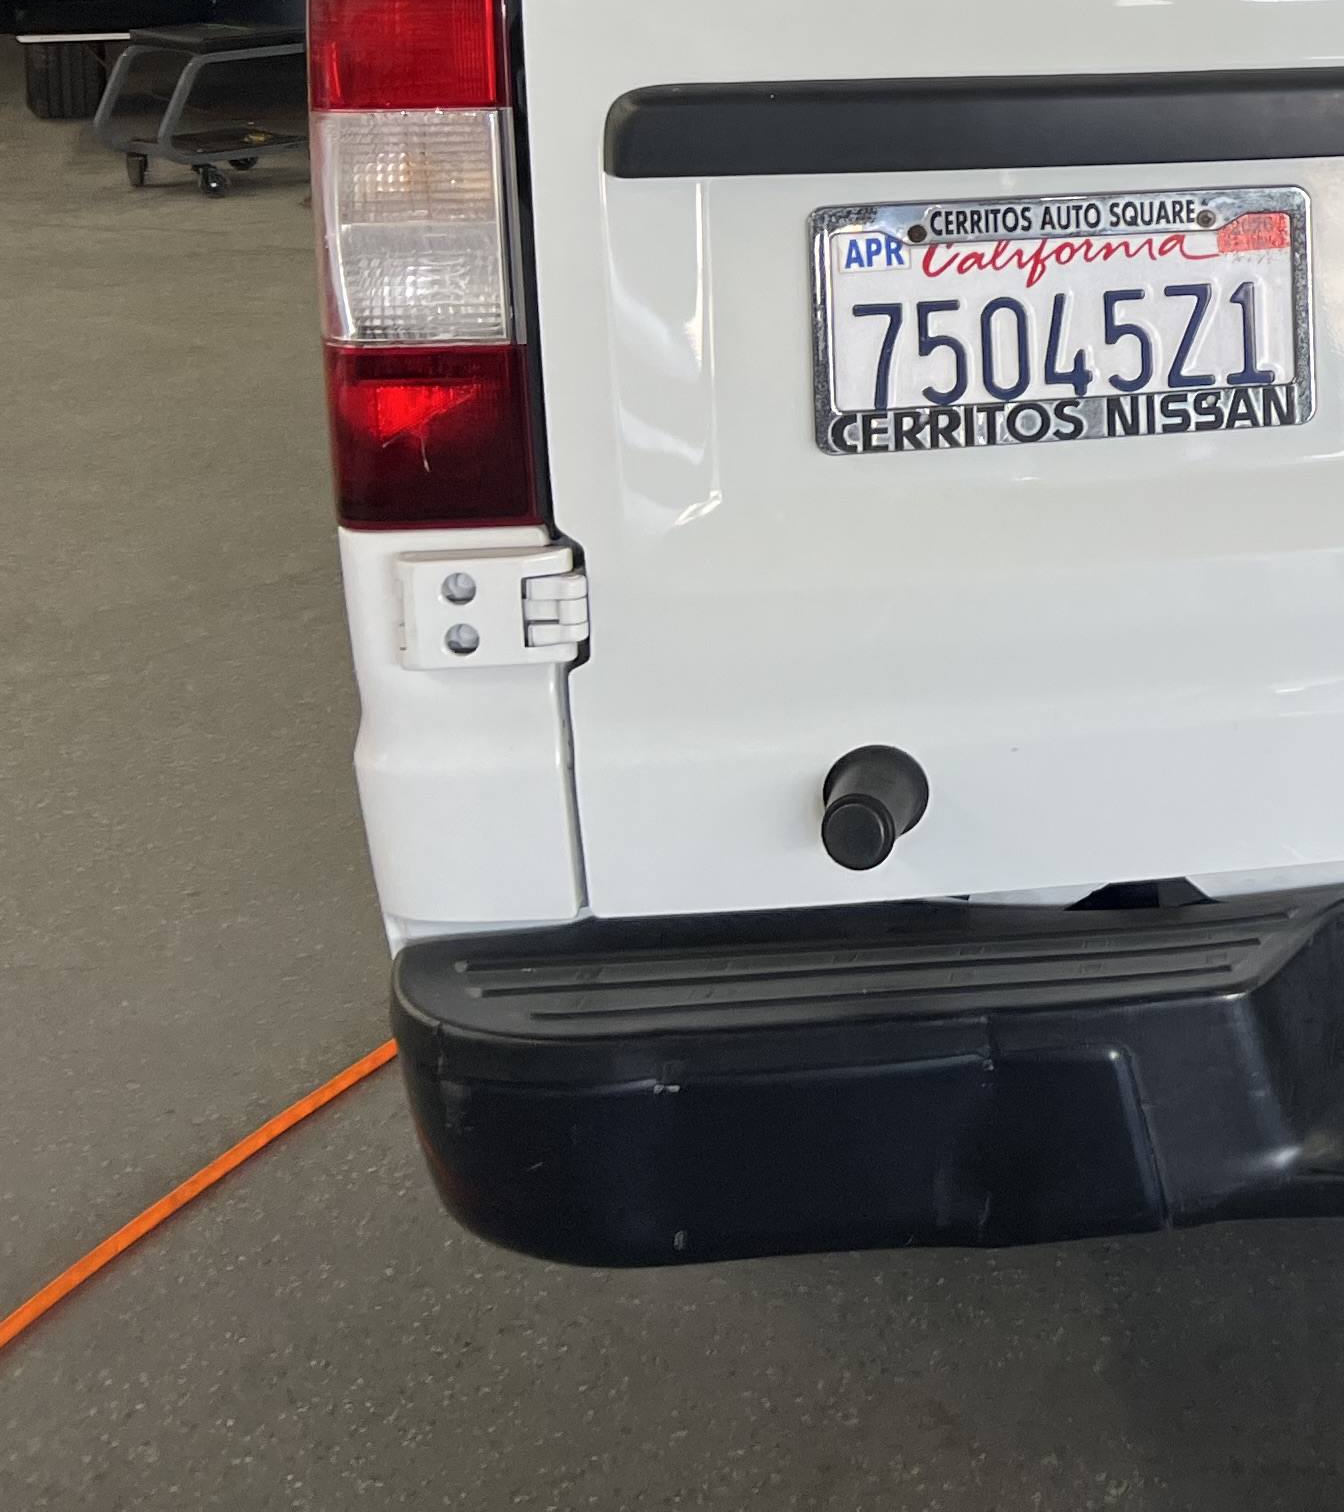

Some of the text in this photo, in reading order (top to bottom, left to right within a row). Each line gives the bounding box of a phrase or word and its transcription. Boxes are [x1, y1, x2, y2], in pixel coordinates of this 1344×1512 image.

[929, 199, 1195, 236] CERRITOS AUTO SQUARE
[844, 235, 905, 269] APR
[922, 234, 1220, 288] California
[852, 281, 1275, 410] 75045Z1
[830, 386, 1296, 453] CERRITOS NISSAN
